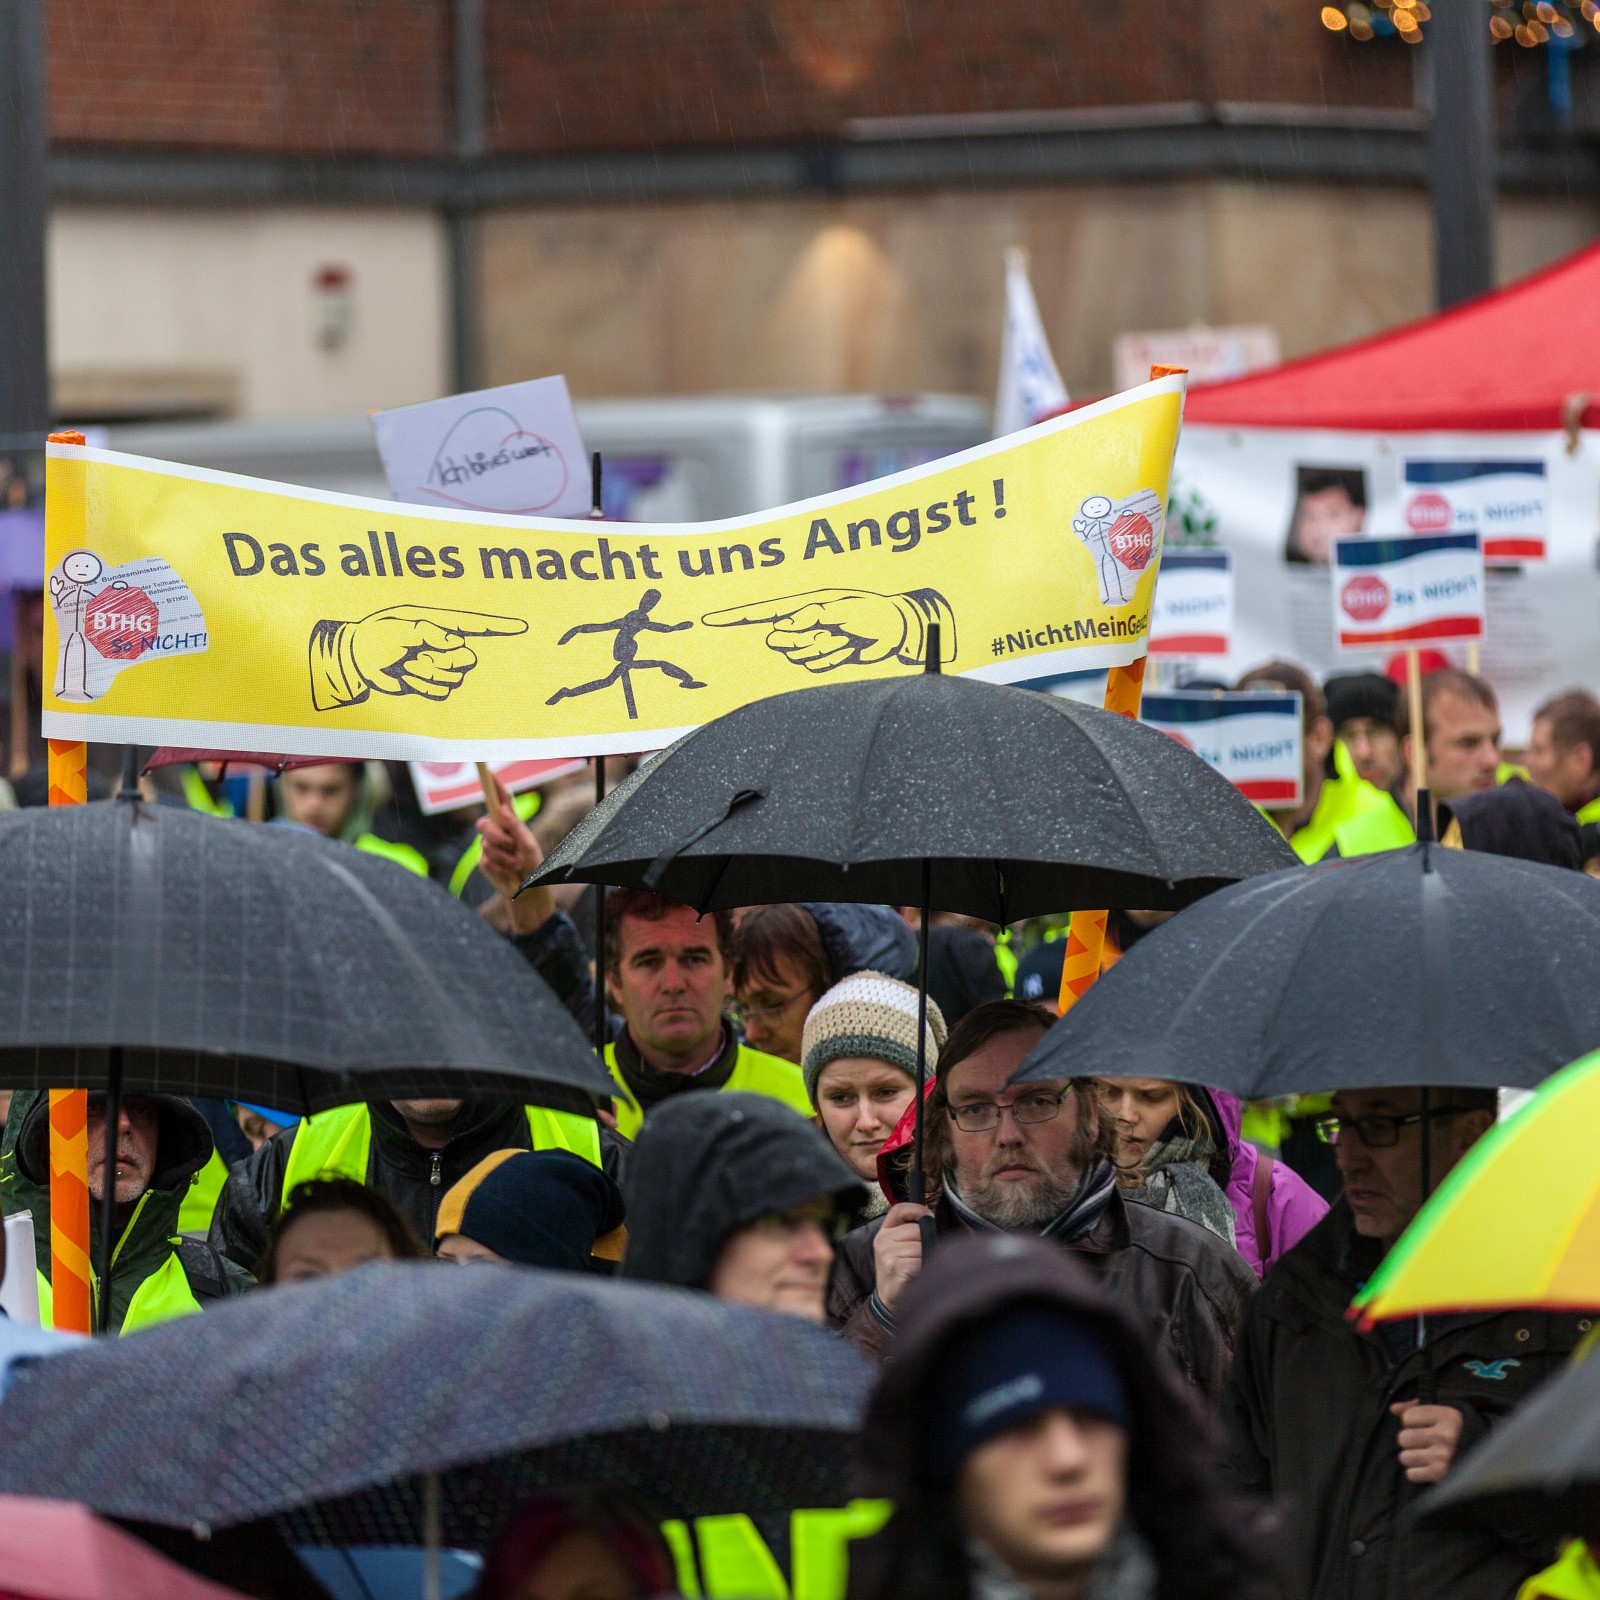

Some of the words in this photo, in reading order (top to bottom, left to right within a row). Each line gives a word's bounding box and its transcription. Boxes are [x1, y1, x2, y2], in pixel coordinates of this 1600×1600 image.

[222, 532, 327, 578] Das
[338, 530, 466, 579] alles
[478, 538, 664, 581] macht
[678, 537, 786, 579] uns
[803, 489, 977, 561] Angst
[992, 478, 1007, 520] !
[1115, 533, 1151, 549] BTHG
[93, 612, 152, 633] BTHG
[111, 638, 133, 654] So
[141, 632, 208, 652] NICHT!
